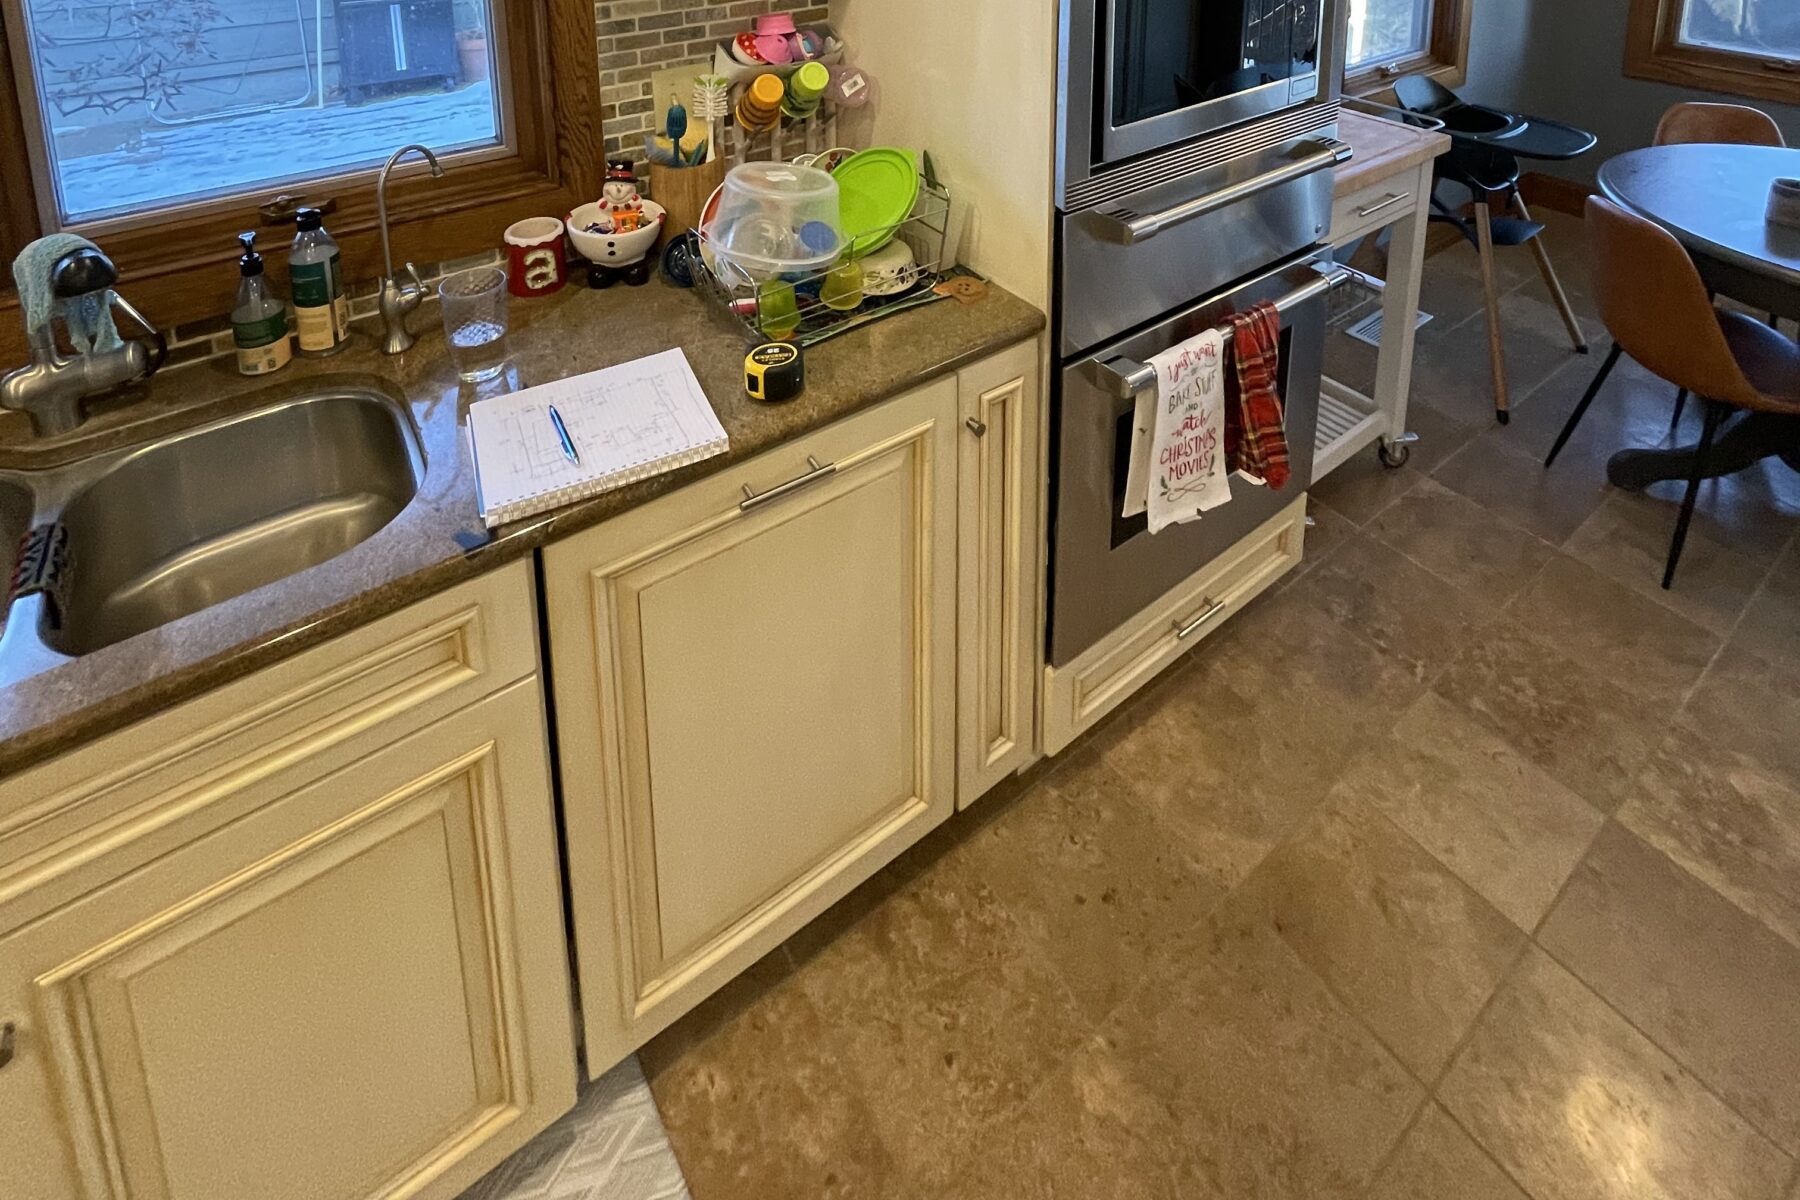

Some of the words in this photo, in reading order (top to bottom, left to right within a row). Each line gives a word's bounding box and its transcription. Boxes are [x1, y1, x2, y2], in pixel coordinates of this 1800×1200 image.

[1167, 365, 1173, 381] I
[1173, 348, 1193, 383] just
[1193, 340, 1217, 361] want
[1168, 384, 1191, 414] BAKE
[1185, 402, 1199, 413] AND
[1171, 409, 1212, 438] watch
[1159, 427, 1217, 465] CHRISTMAS
